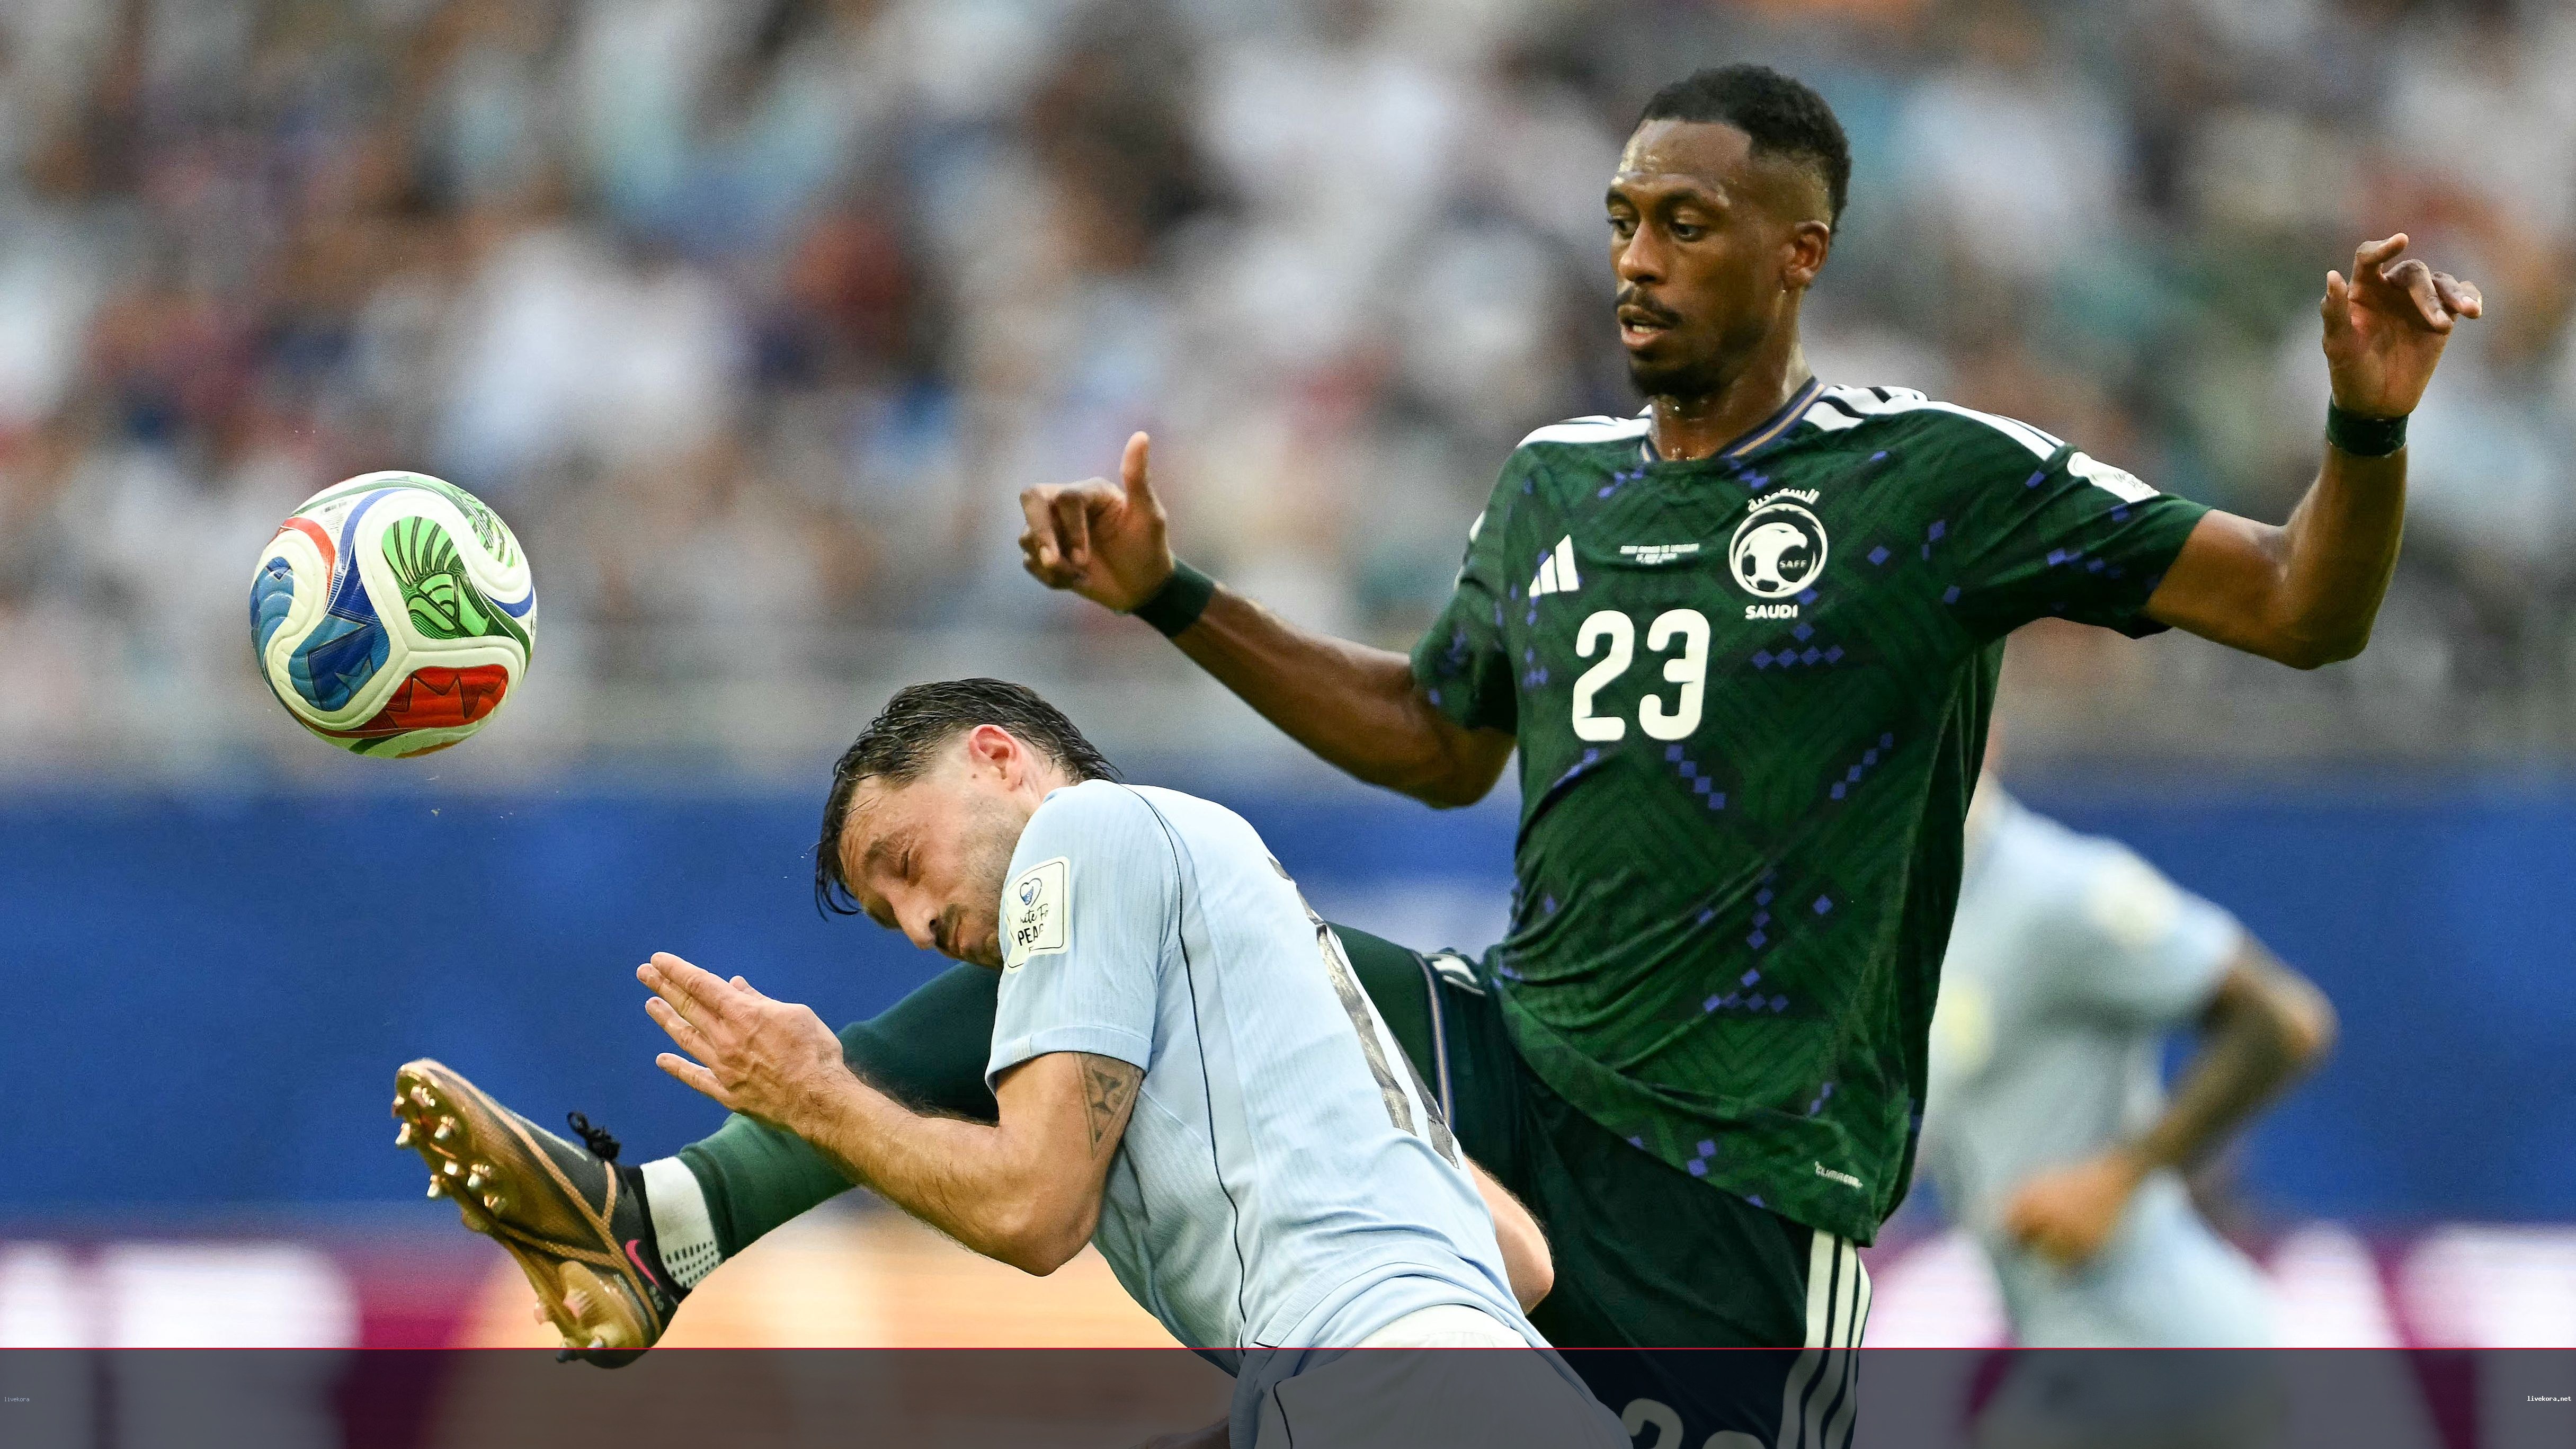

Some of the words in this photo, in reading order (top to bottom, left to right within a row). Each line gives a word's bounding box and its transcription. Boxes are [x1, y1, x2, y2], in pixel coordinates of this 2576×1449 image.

[1749, 488, 1820, 512] السعودية
[1780, 560, 1807, 568] SAFF
[1745, 604, 1798, 619] SAUDI
[1572, 609, 1710, 741] 23
